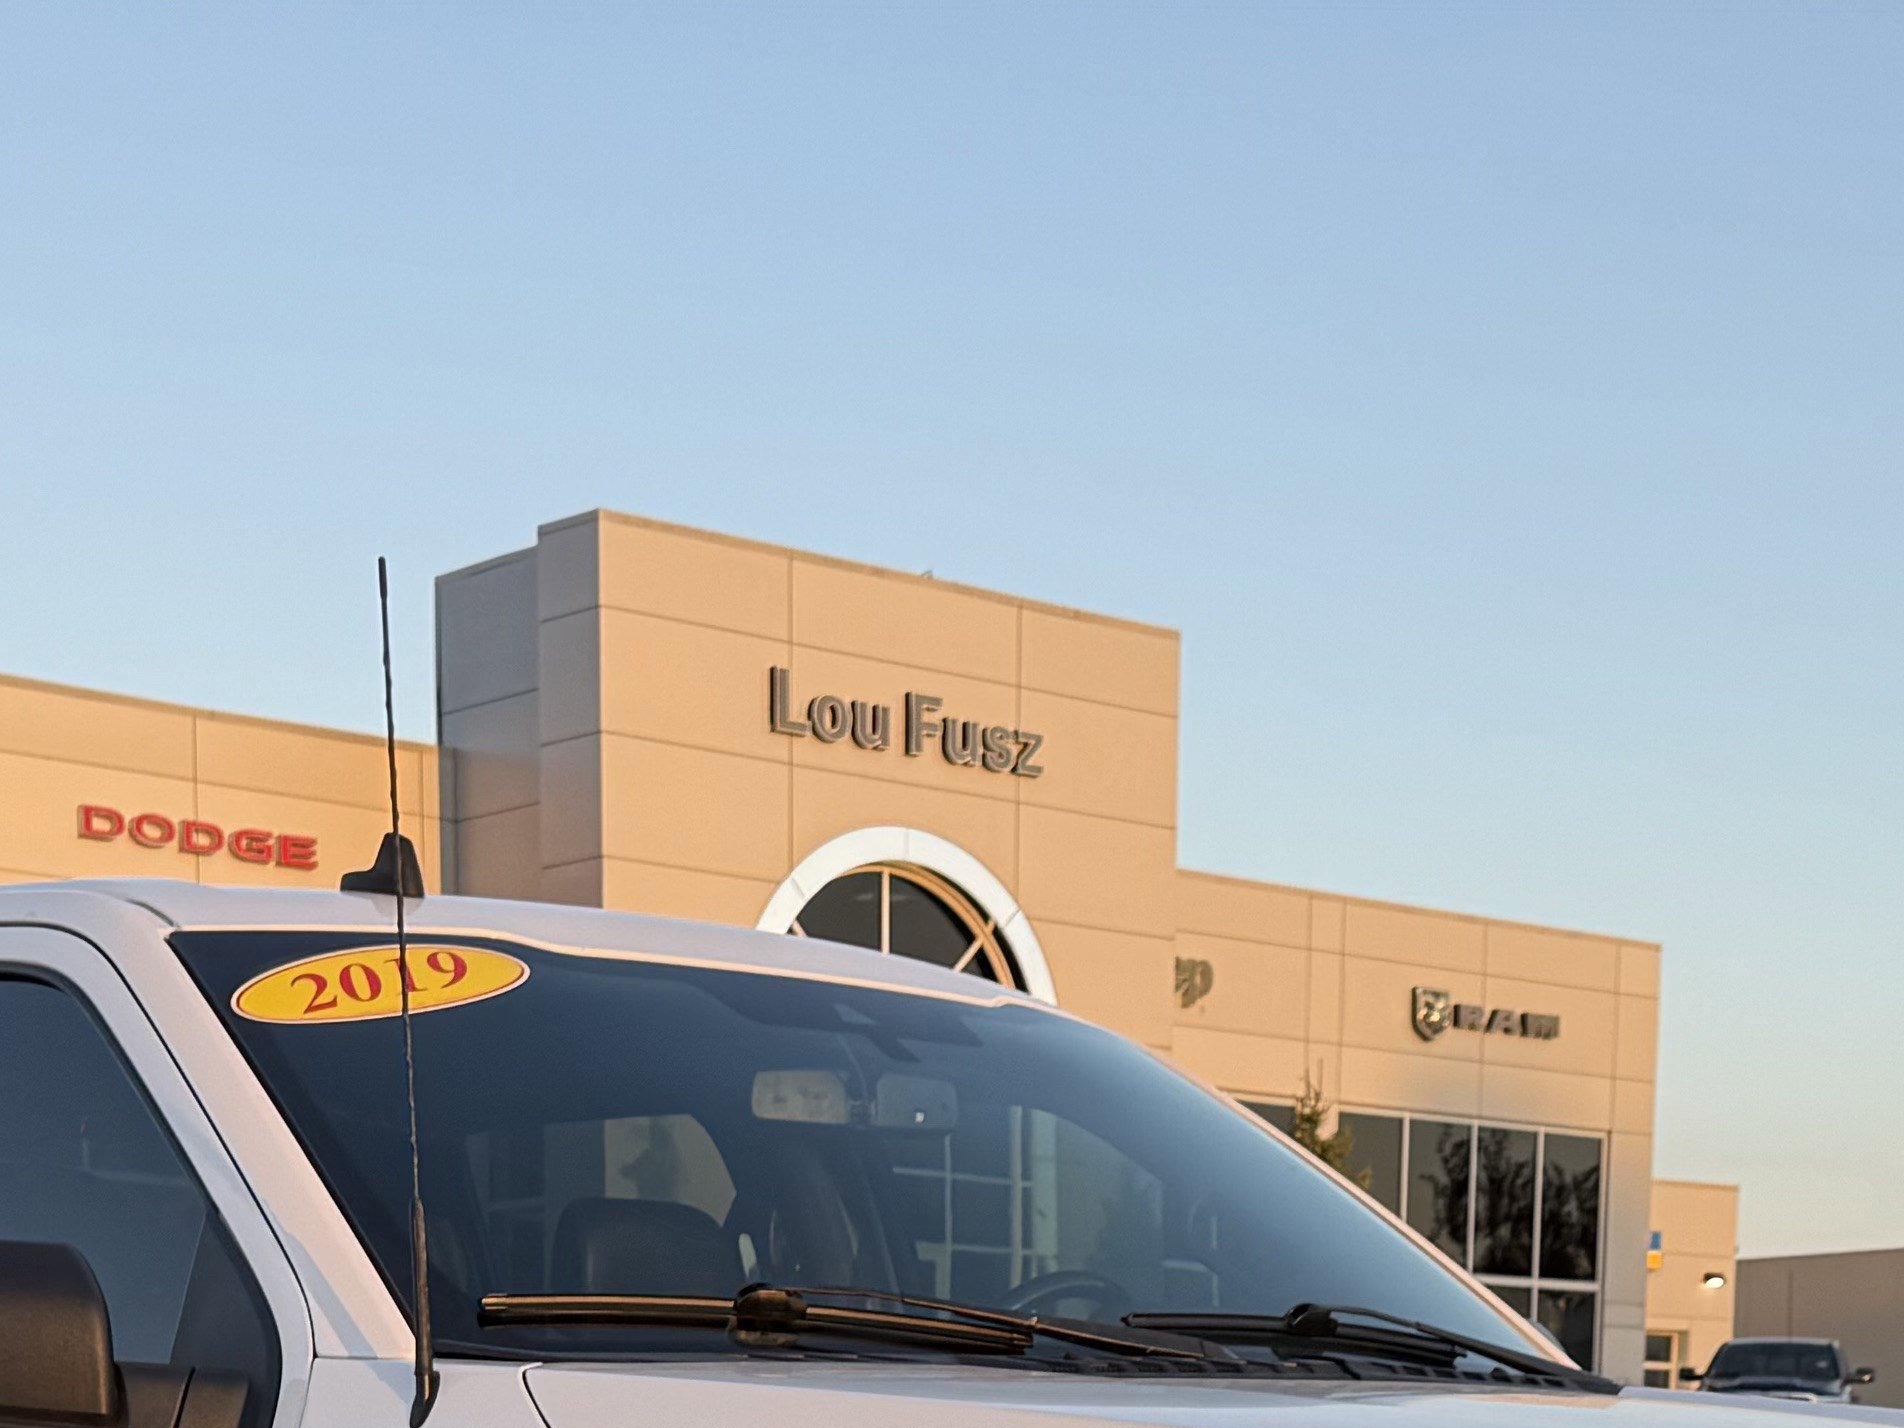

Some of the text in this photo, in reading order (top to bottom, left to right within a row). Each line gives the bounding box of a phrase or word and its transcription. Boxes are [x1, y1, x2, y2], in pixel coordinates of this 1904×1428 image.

[769, 665, 1045, 778] Lou Fusz
[77, 804, 319, 871] DODGE
[1453, 1003, 1560, 1041] RAM
